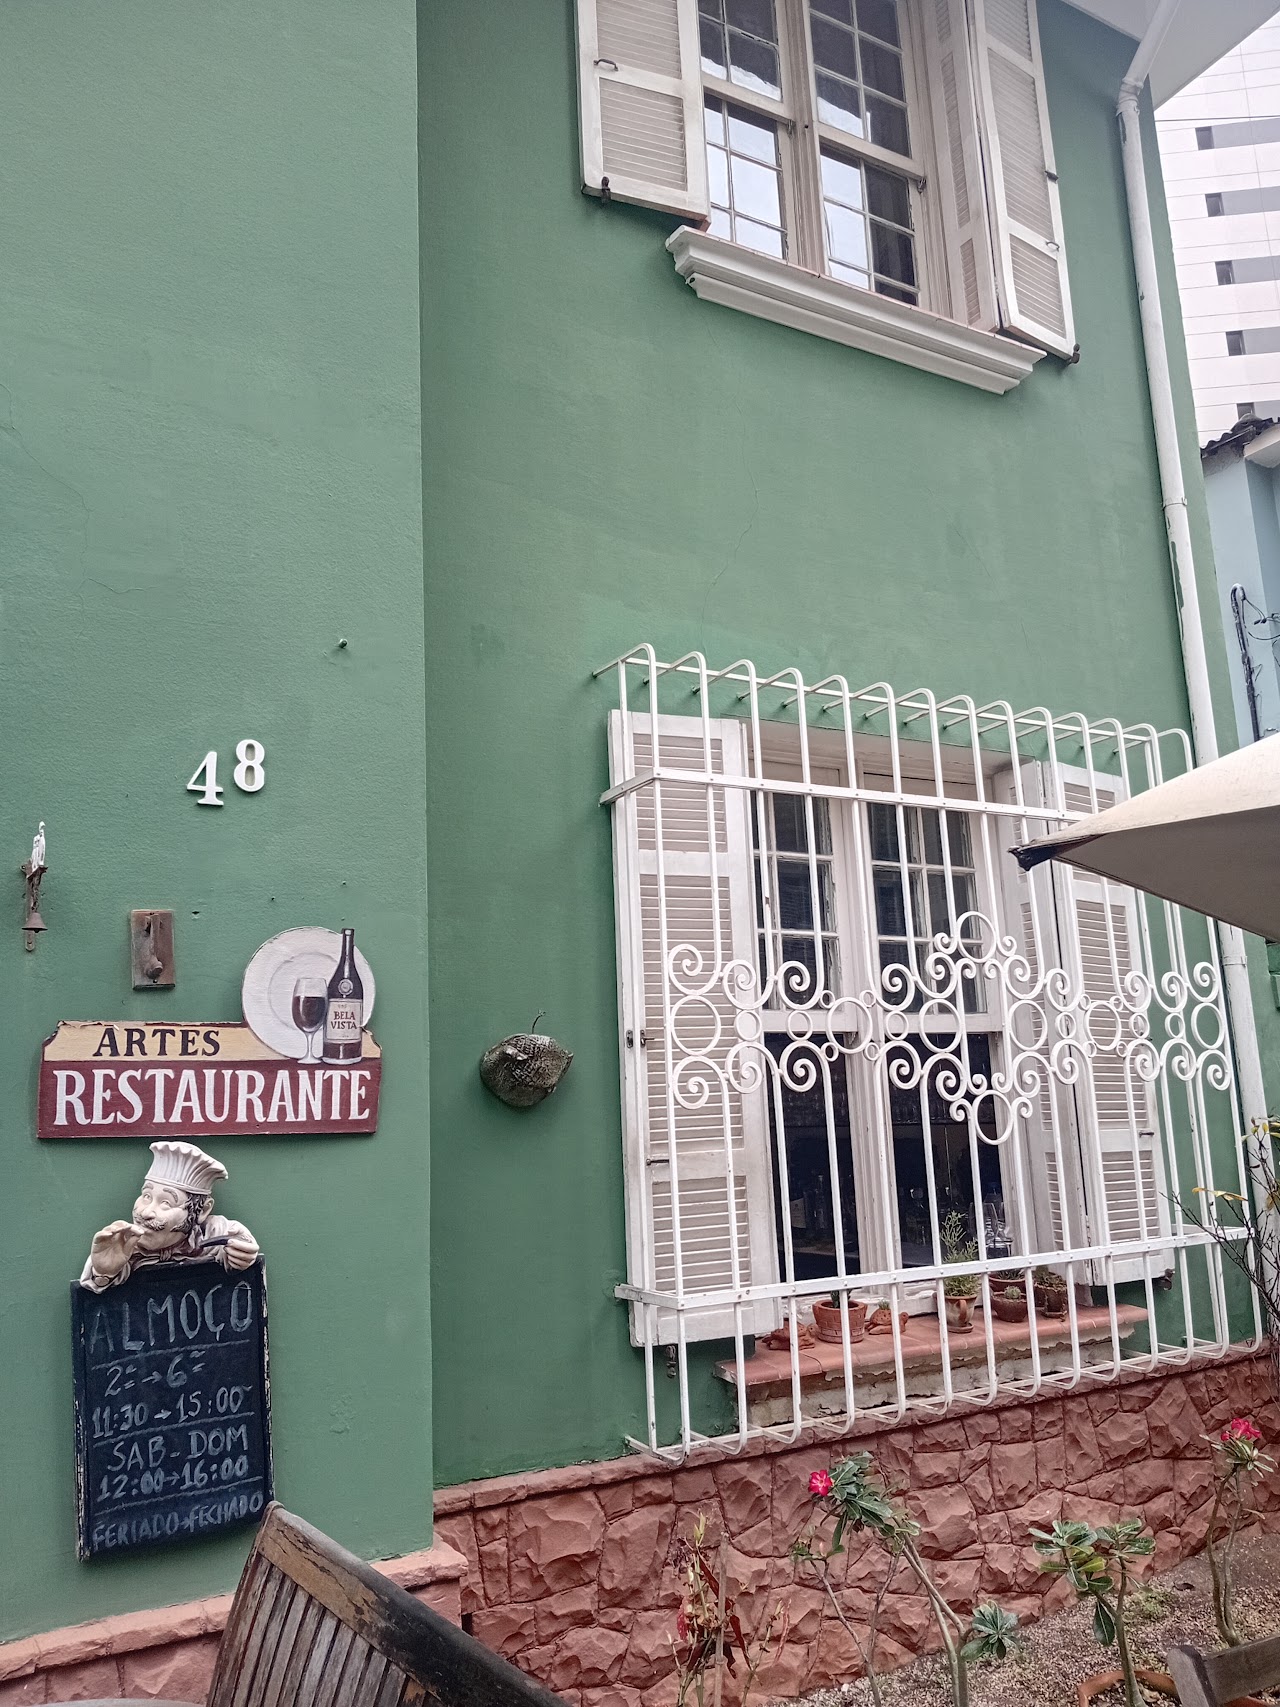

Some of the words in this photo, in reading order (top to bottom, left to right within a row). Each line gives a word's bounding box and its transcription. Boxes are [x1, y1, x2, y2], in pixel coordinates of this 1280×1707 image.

[186, 739, 266, 806] 48
[331, 1021, 358, 1030] VISTA
[333, 1010, 356, 1021] BELA
[92, 1027, 221, 1057] ARTES
[53, 1068, 372, 1126] RESTAURANTE
[89, 1280, 253, 1353] ALMOÇO
[91, 1402, 149, 1439] 11:30
[176, 1386, 247, 1423] 15:00
[186, 1423, 249, 1460] DOM
[97, 1467, 165, 1503] 12:00
[180, 1455, 249, 1490] 16:00
[92, 1511, 180, 1552] FERIADO
[189, 1491, 264, 1533] FECHADO
